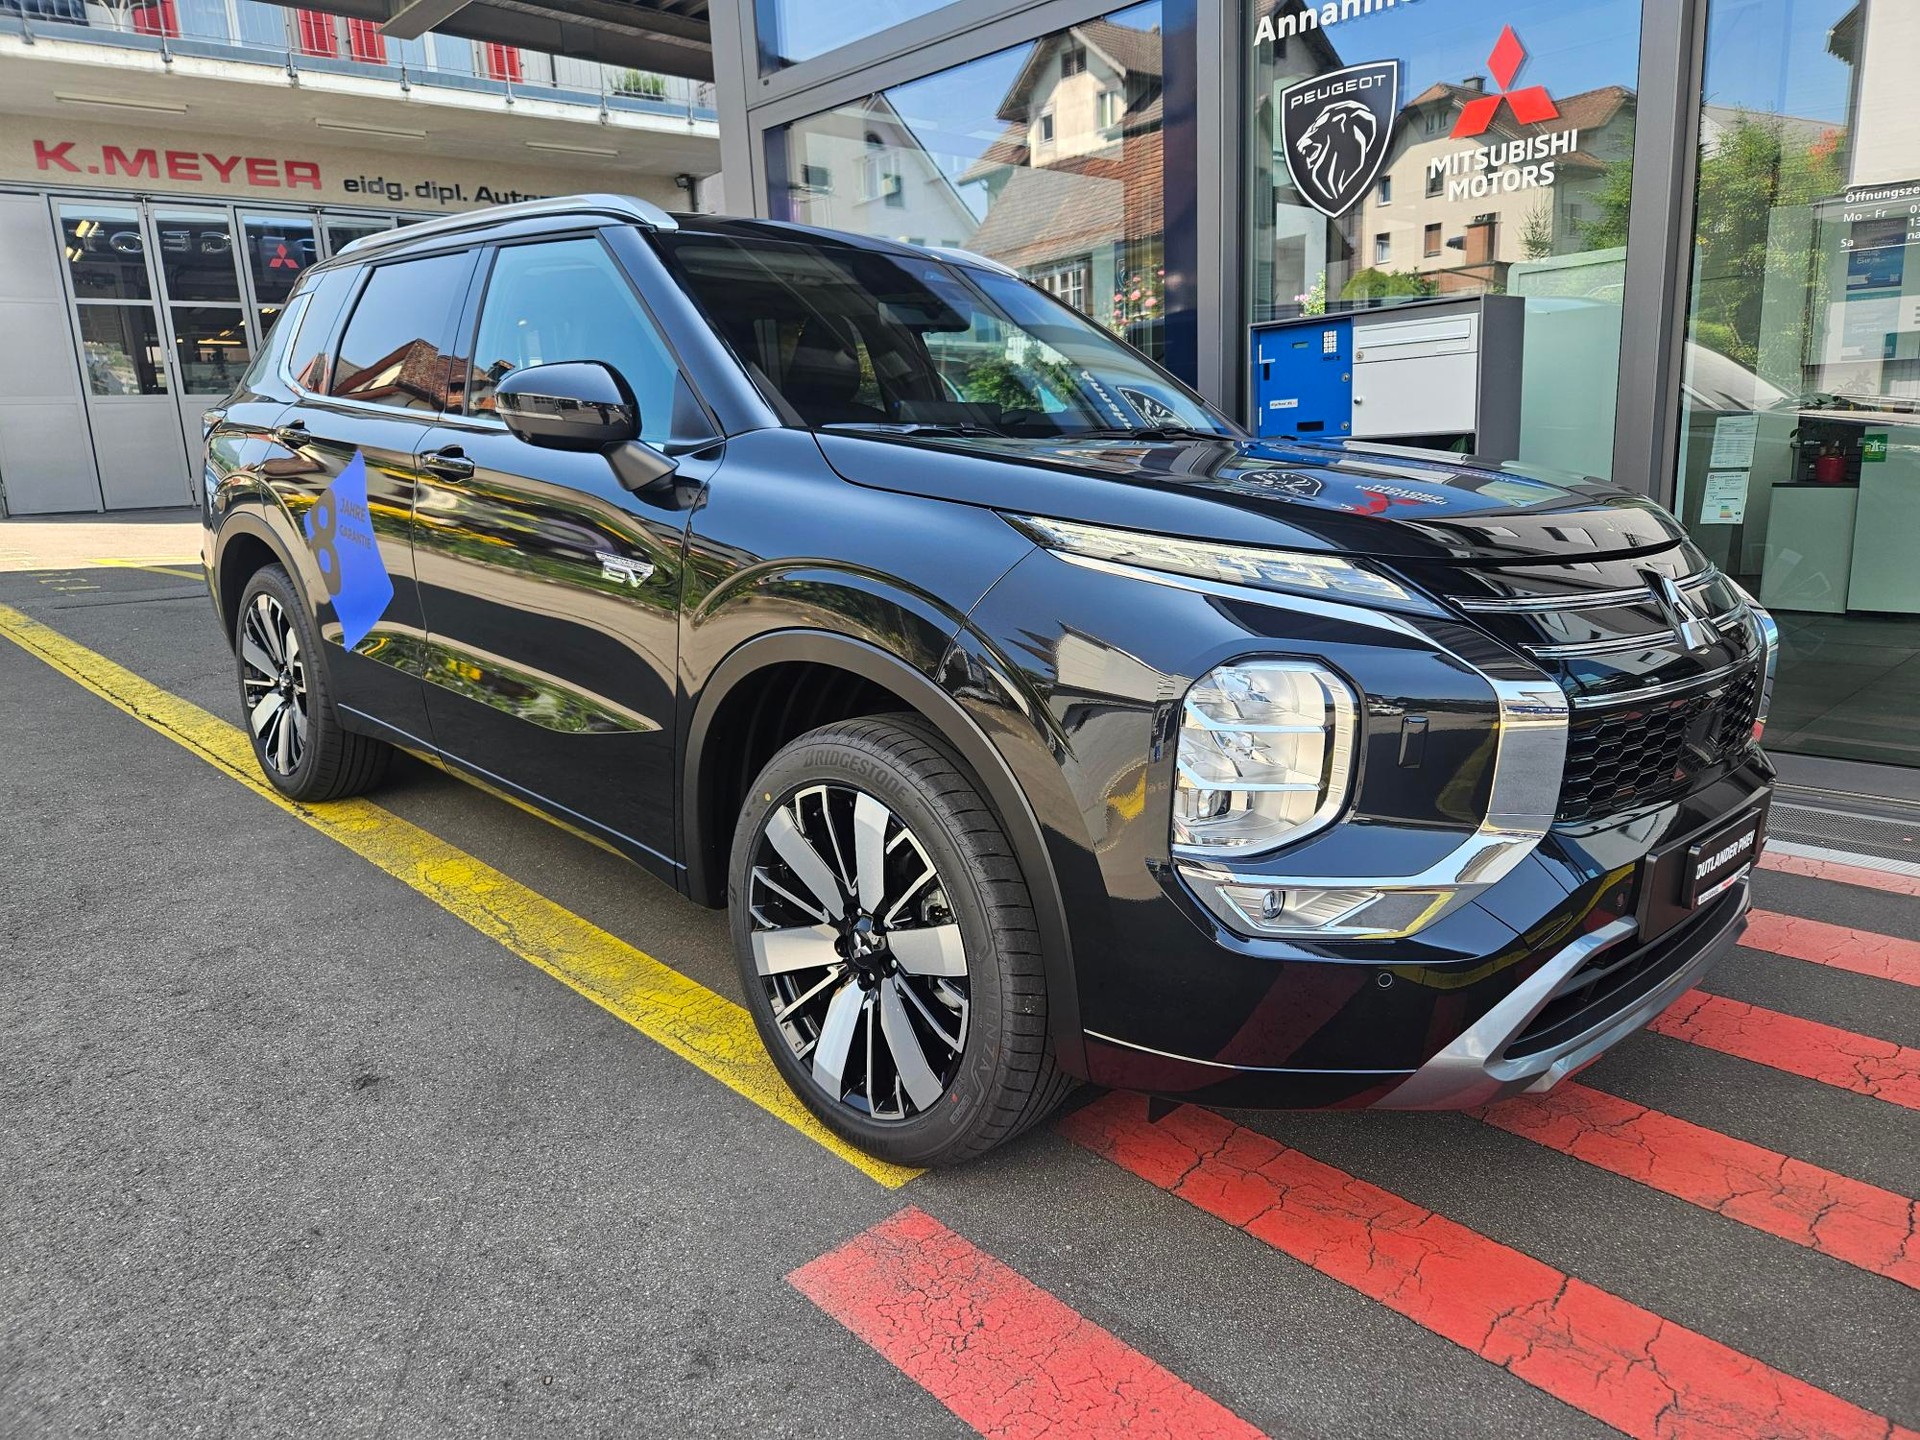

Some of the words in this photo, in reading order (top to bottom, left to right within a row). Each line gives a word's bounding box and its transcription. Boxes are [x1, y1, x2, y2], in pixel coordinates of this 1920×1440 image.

[1290, 74, 1387, 110] PEUGEOT
[32, 139, 323, 190] K.MEYER
[1430, 128, 1578, 179] MITSUBISHI
[343, 175, 409, 201] eidg.
[415, 180, 468, 205] dipl.
[1448, 161, 1555, 202] MOTORS
[1845, 186, 1920, 203] Öffnungsze
[1843, 212, 1863, 223] Mo
[1875, 208, 1887, 219] Fr
[1840, 238, 1854, 248] Sa
[340, 497, 366, 523] JAHRE
[310, 487, 342, 597] 8
[338, 525, 372, 550] GARANTIE
[802, 749, 910, 800] BRIDGESTONE
[1695, 841, 1739, 880] OUTLANDER
